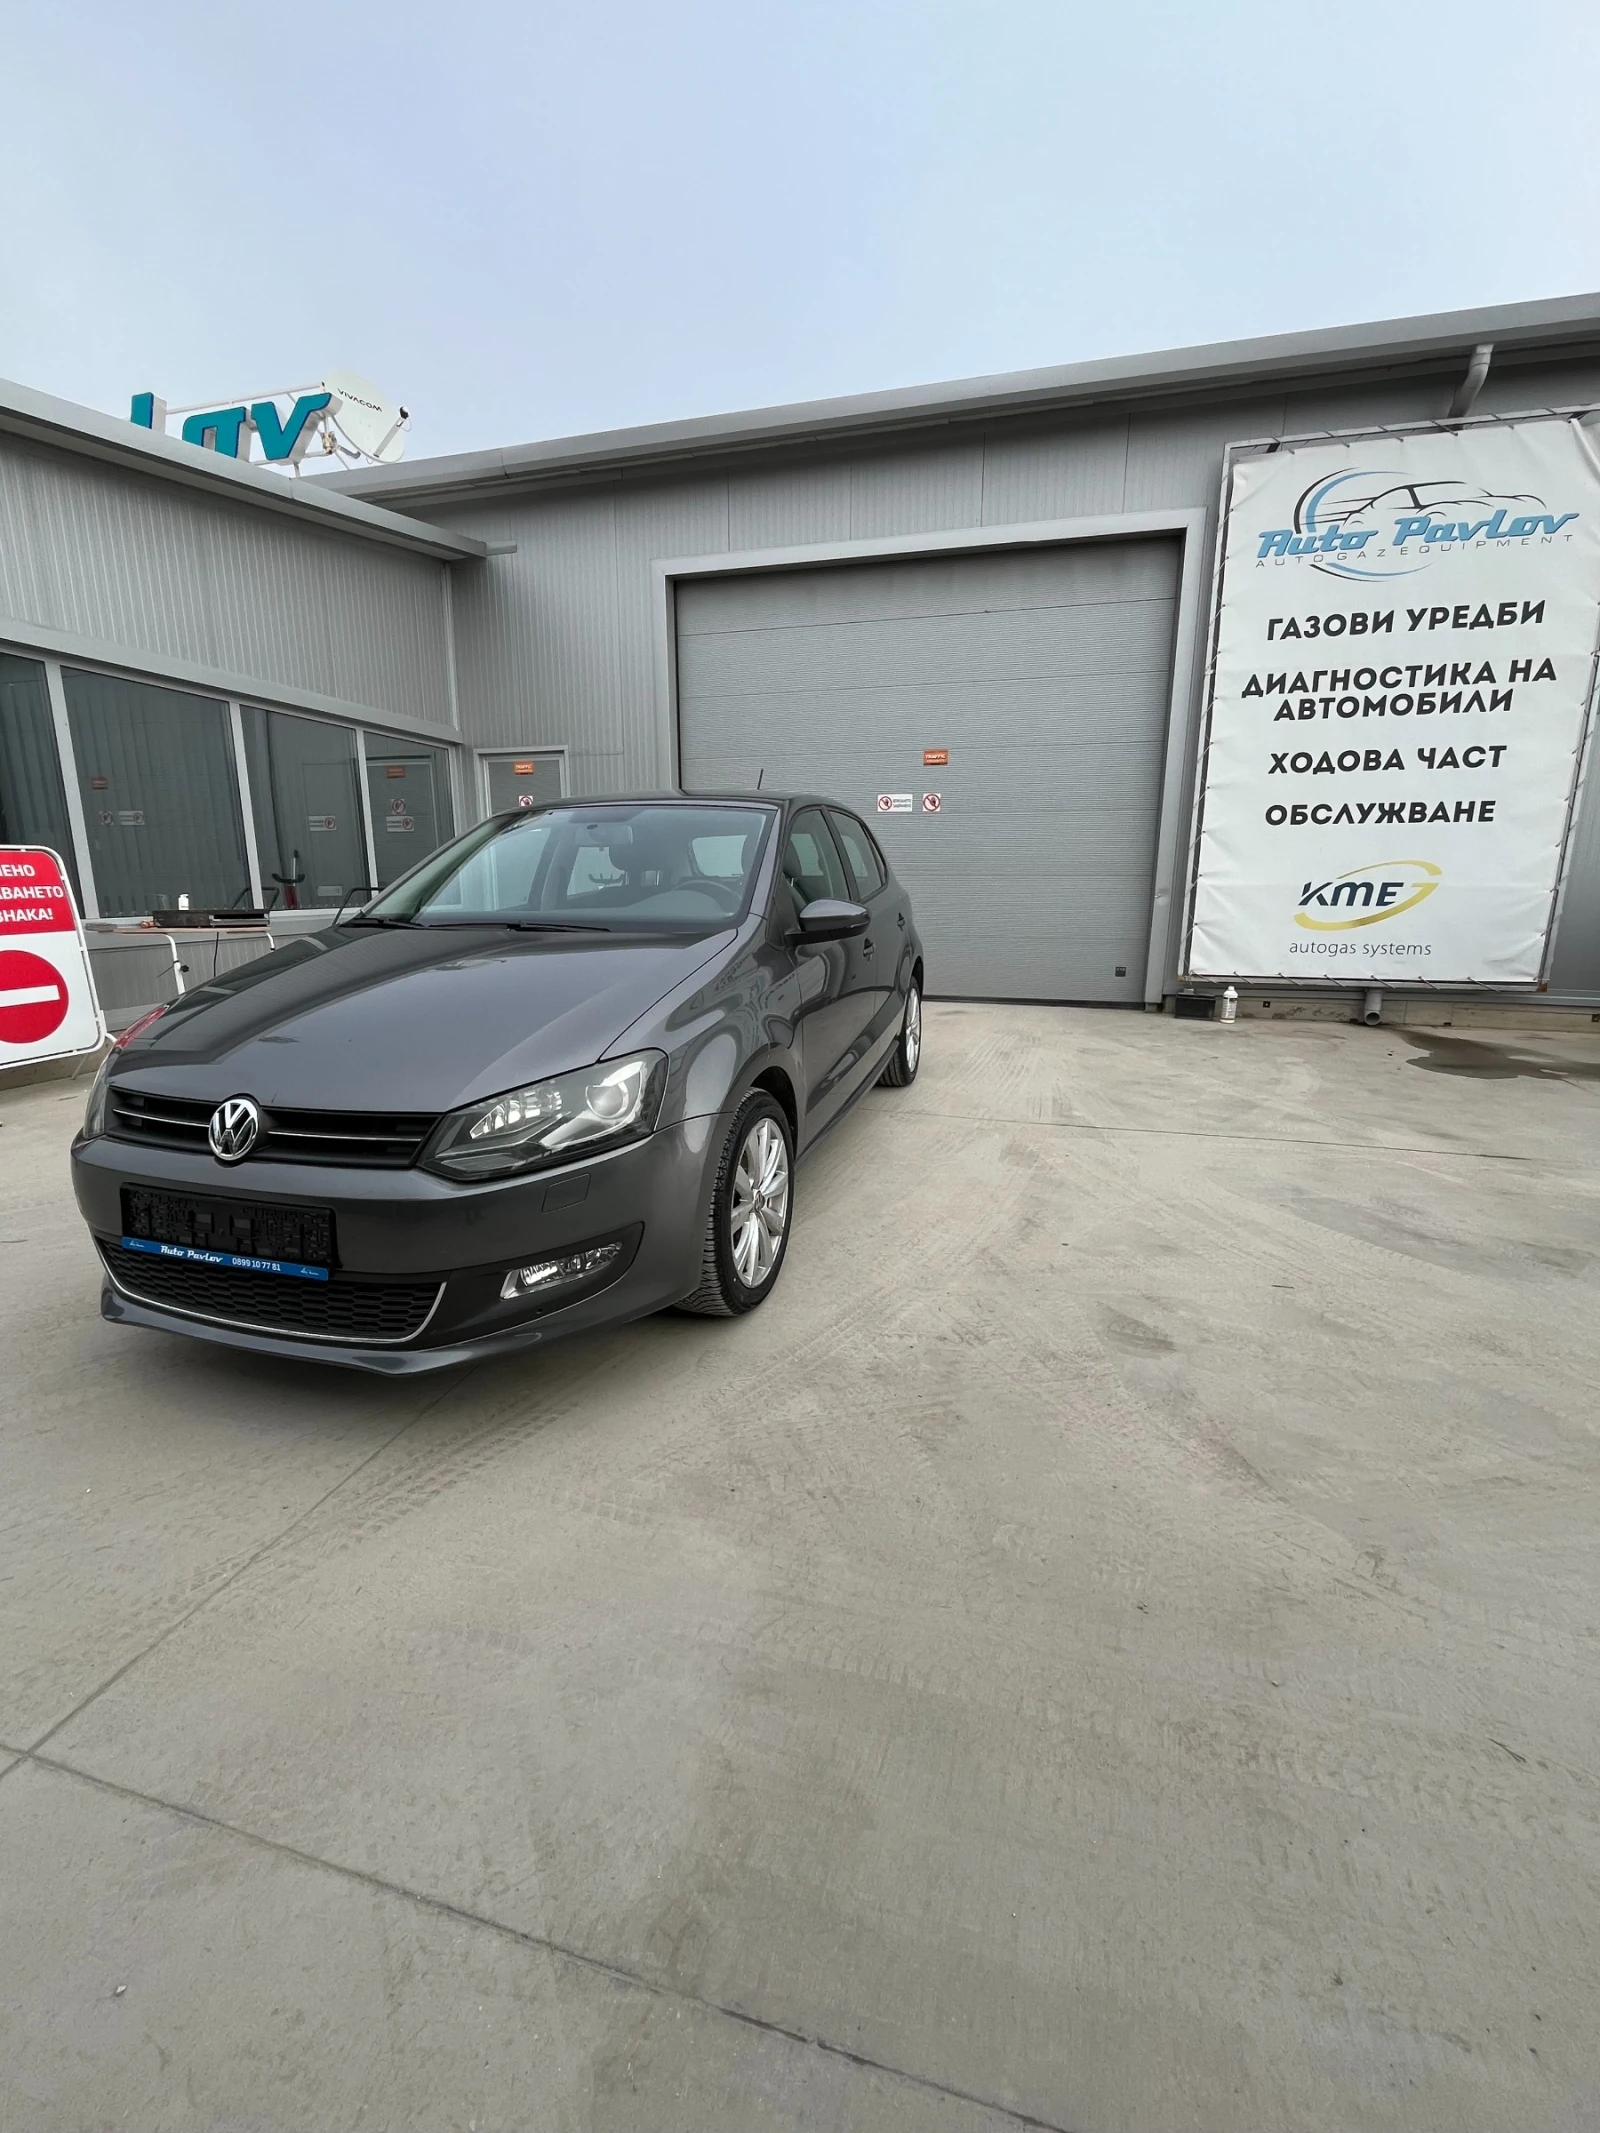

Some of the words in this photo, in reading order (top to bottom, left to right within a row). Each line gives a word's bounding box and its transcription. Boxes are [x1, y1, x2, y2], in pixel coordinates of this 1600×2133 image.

[337, 388, 382, 412] VIVACOM
[1256, 524, 1378, 558] Auto
[1392, 509, 1580, 546] Pavlov
[1267, 610, 1394, 641] ГАЗОВИ
[1407, 600, 1546, 631] УРЕДБИ
[1242, 661, 1496, 698] ДИАГНОСТИКА
[1509, 658, 1557, 683] НА
[1273, 689, 1514, 721] АВТОМОБИЛИ
[1268, 749, 1405, 775] ХОДОВА
[1417, 745, 1507, 769] ЧАСТ
[1265, 800, 1496, 826] ОБСЛУЖВАНЕ
[1298, 881, 1404, 907] KME
[1289, 941, 1357, 957] autogas
[1363, 942, 1432, 957] systems
[160, 1245, 184, 1257] Auto
[187, 1249, 224, 1263] Pavlov
[232, 1257, 250, 1267] 0899
[251, 1260, 261, 1269] 10
[261, 1262, 271, 1270] 77
[271, 1263, 281, 1271] 81
